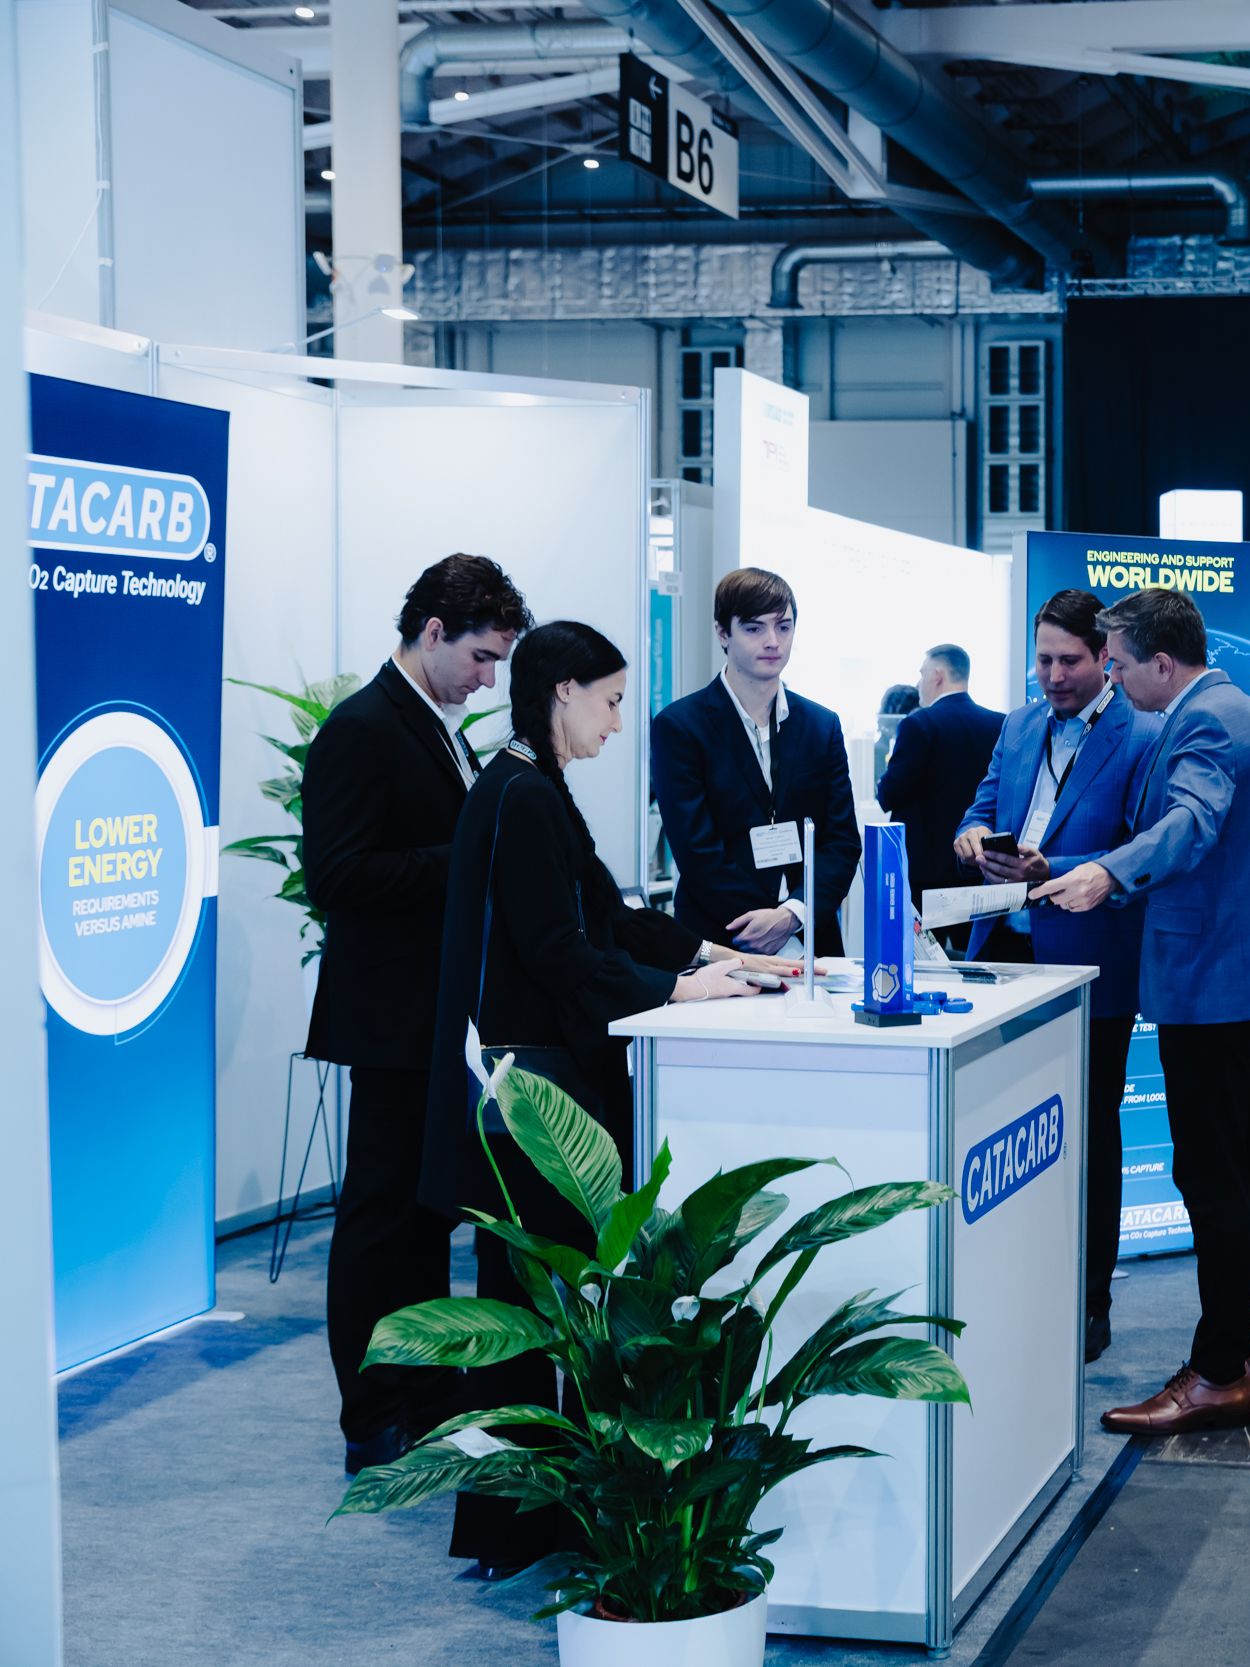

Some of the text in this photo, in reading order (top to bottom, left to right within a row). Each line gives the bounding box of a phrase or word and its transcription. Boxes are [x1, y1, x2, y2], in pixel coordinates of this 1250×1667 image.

[676, 110, 714, 196] B6
[1086, 550, 1235, 569] ENGINEERING AND SUPPORT
[52, 565, 118, 598] Capture
[121, 570, 207, 605] Technology
[1086, 564, 1235, 593] WORLDWIDE
[75, 813, 158, 850] LOWER
[68, 847, 163, 888] ENERGY
[72, 890, 160, 916] REQUIREMENTS
[74, 910, 157, 937] VERSUS AMINE
[966, 1103, 1059, 1213] CATACARB
[1130, 1162, 1165, 1175] CAPTURE
[1143, 1228, 1167, 1239] Capture
